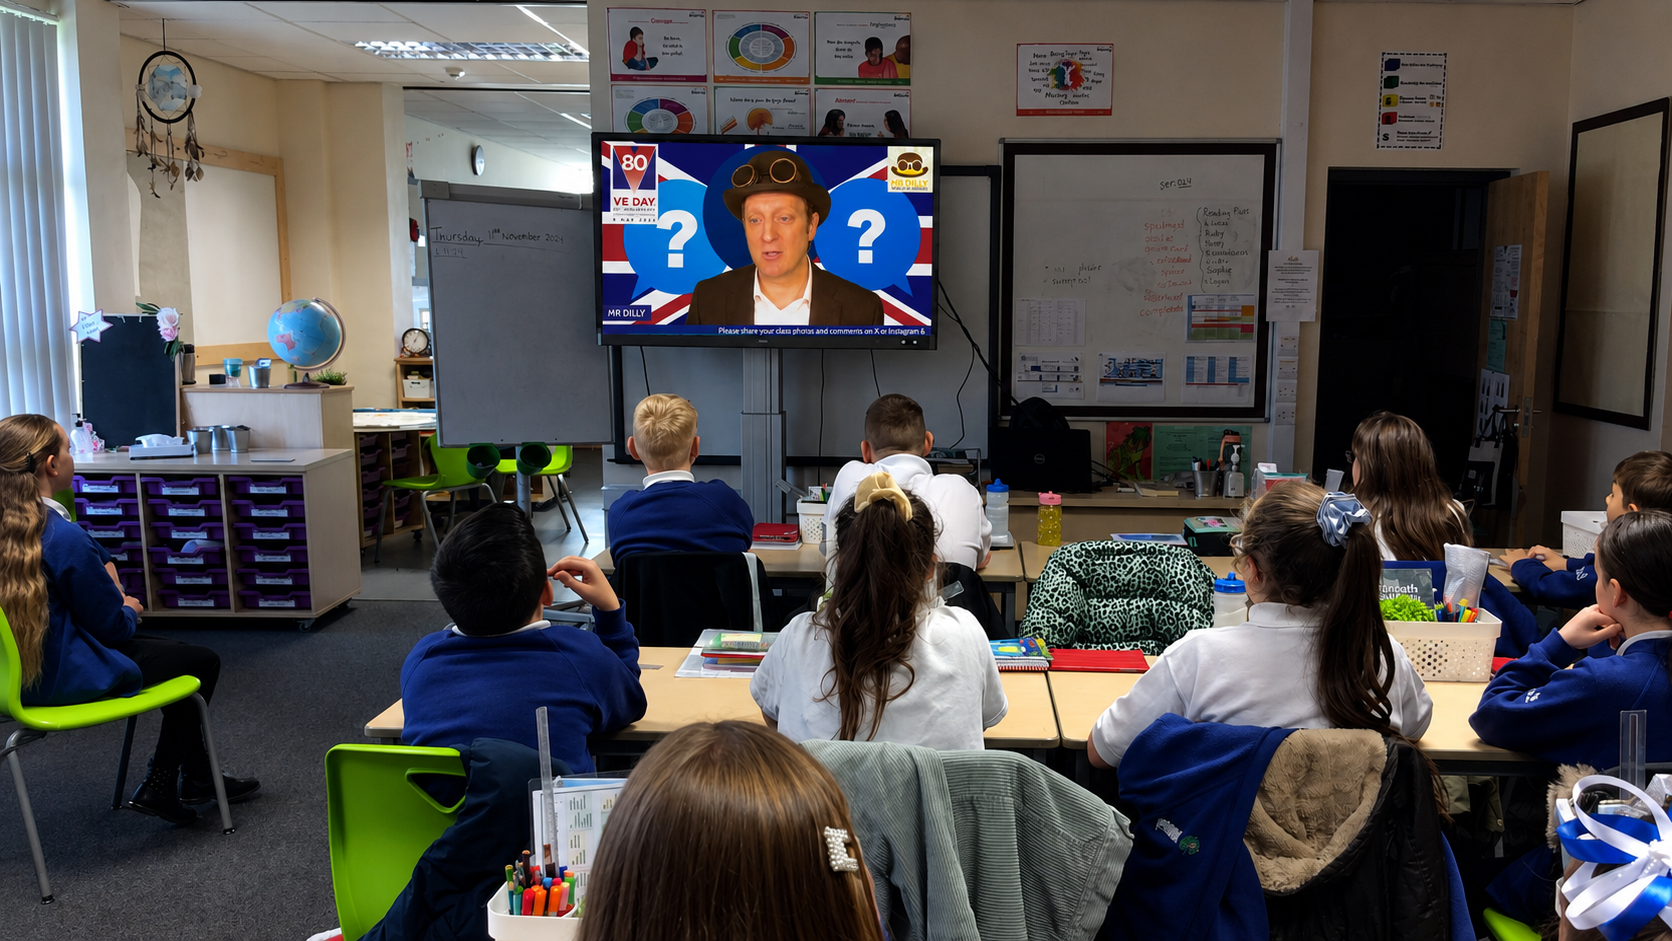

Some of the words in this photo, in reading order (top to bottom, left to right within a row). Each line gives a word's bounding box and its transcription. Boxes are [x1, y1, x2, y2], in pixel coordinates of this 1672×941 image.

[621, 154, 648, 171] 80
[613, 197, 629, 206] VE
[632, 197, 656, 206] DAY
[430, 227, 484, 247] Thursday
[502, 232, 541, 242] November
[545, 233, 564, 244] 2024
[607, 309, 621, 317] MR
[623, 309, 646, 318] DILLY
[775, 327, 791, 335] class
[792, 327, 814, 336] photos
[815, 327, 829, 335] and
[888, 328, 919, 336] Instagram
